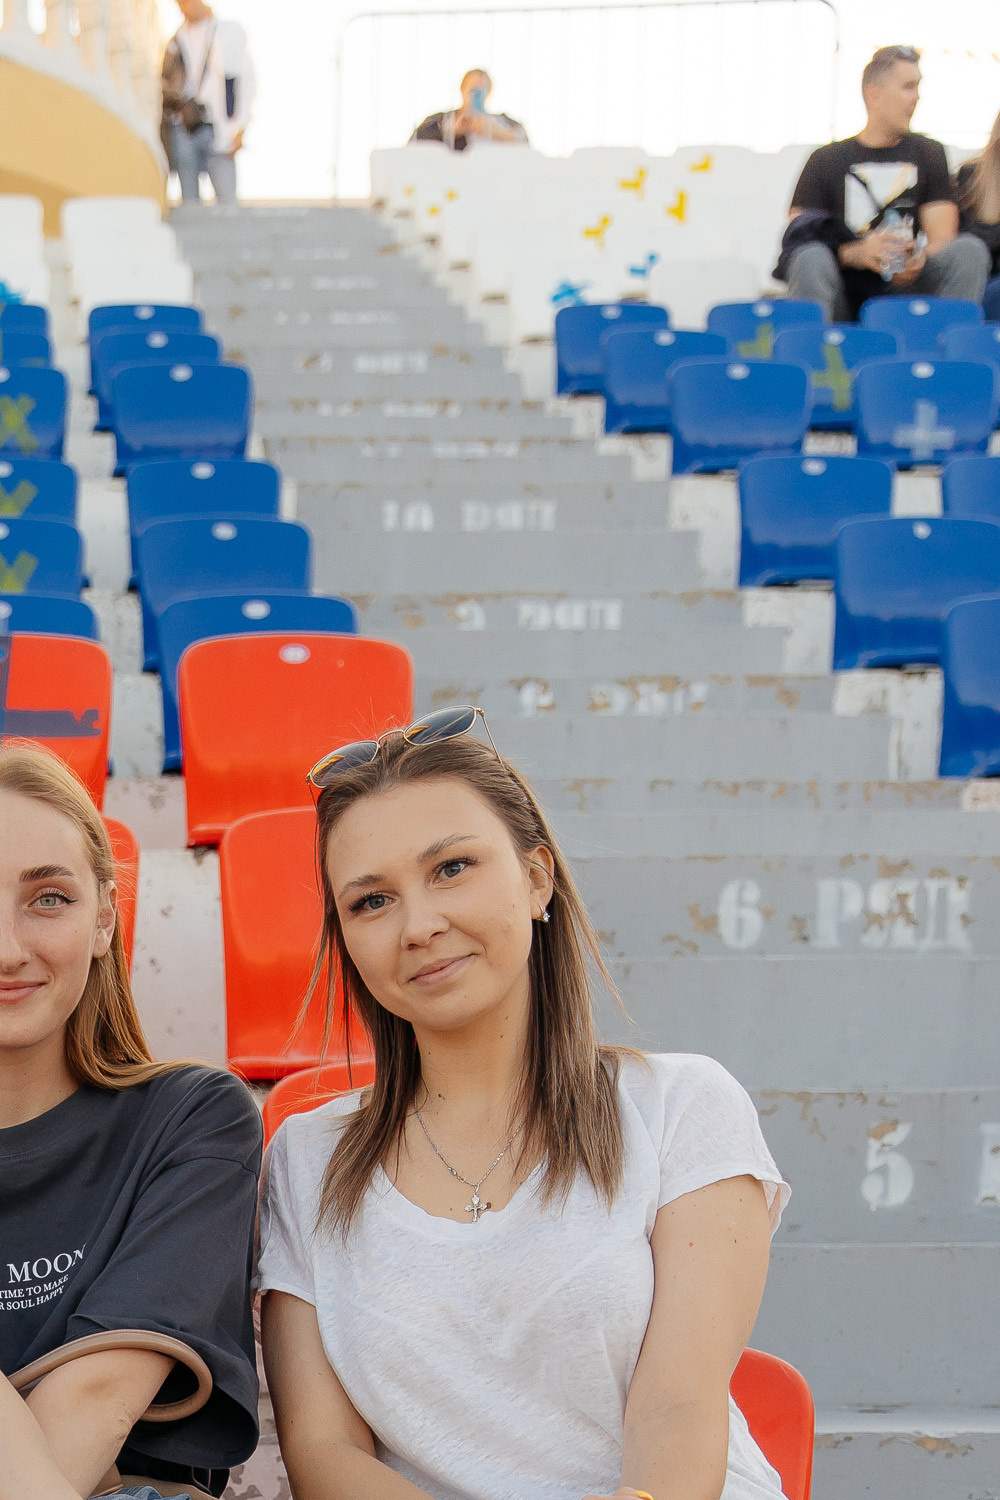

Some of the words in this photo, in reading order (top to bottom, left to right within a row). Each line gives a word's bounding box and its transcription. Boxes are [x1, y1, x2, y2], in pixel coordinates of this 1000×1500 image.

[718, 878, 763, 950] 6
[811, 877, 973, 956] РЯД
[860, 1121, 914, 1211] 5
[6, 1242, 87, 1285] MOON
[25, 1284, 42, 1297] TO
[43, 1273, 69, 1293] MAKE
[6, 1298, 36, 1311] SOUL
[36, 1285, 65, 1306] HAPPY
